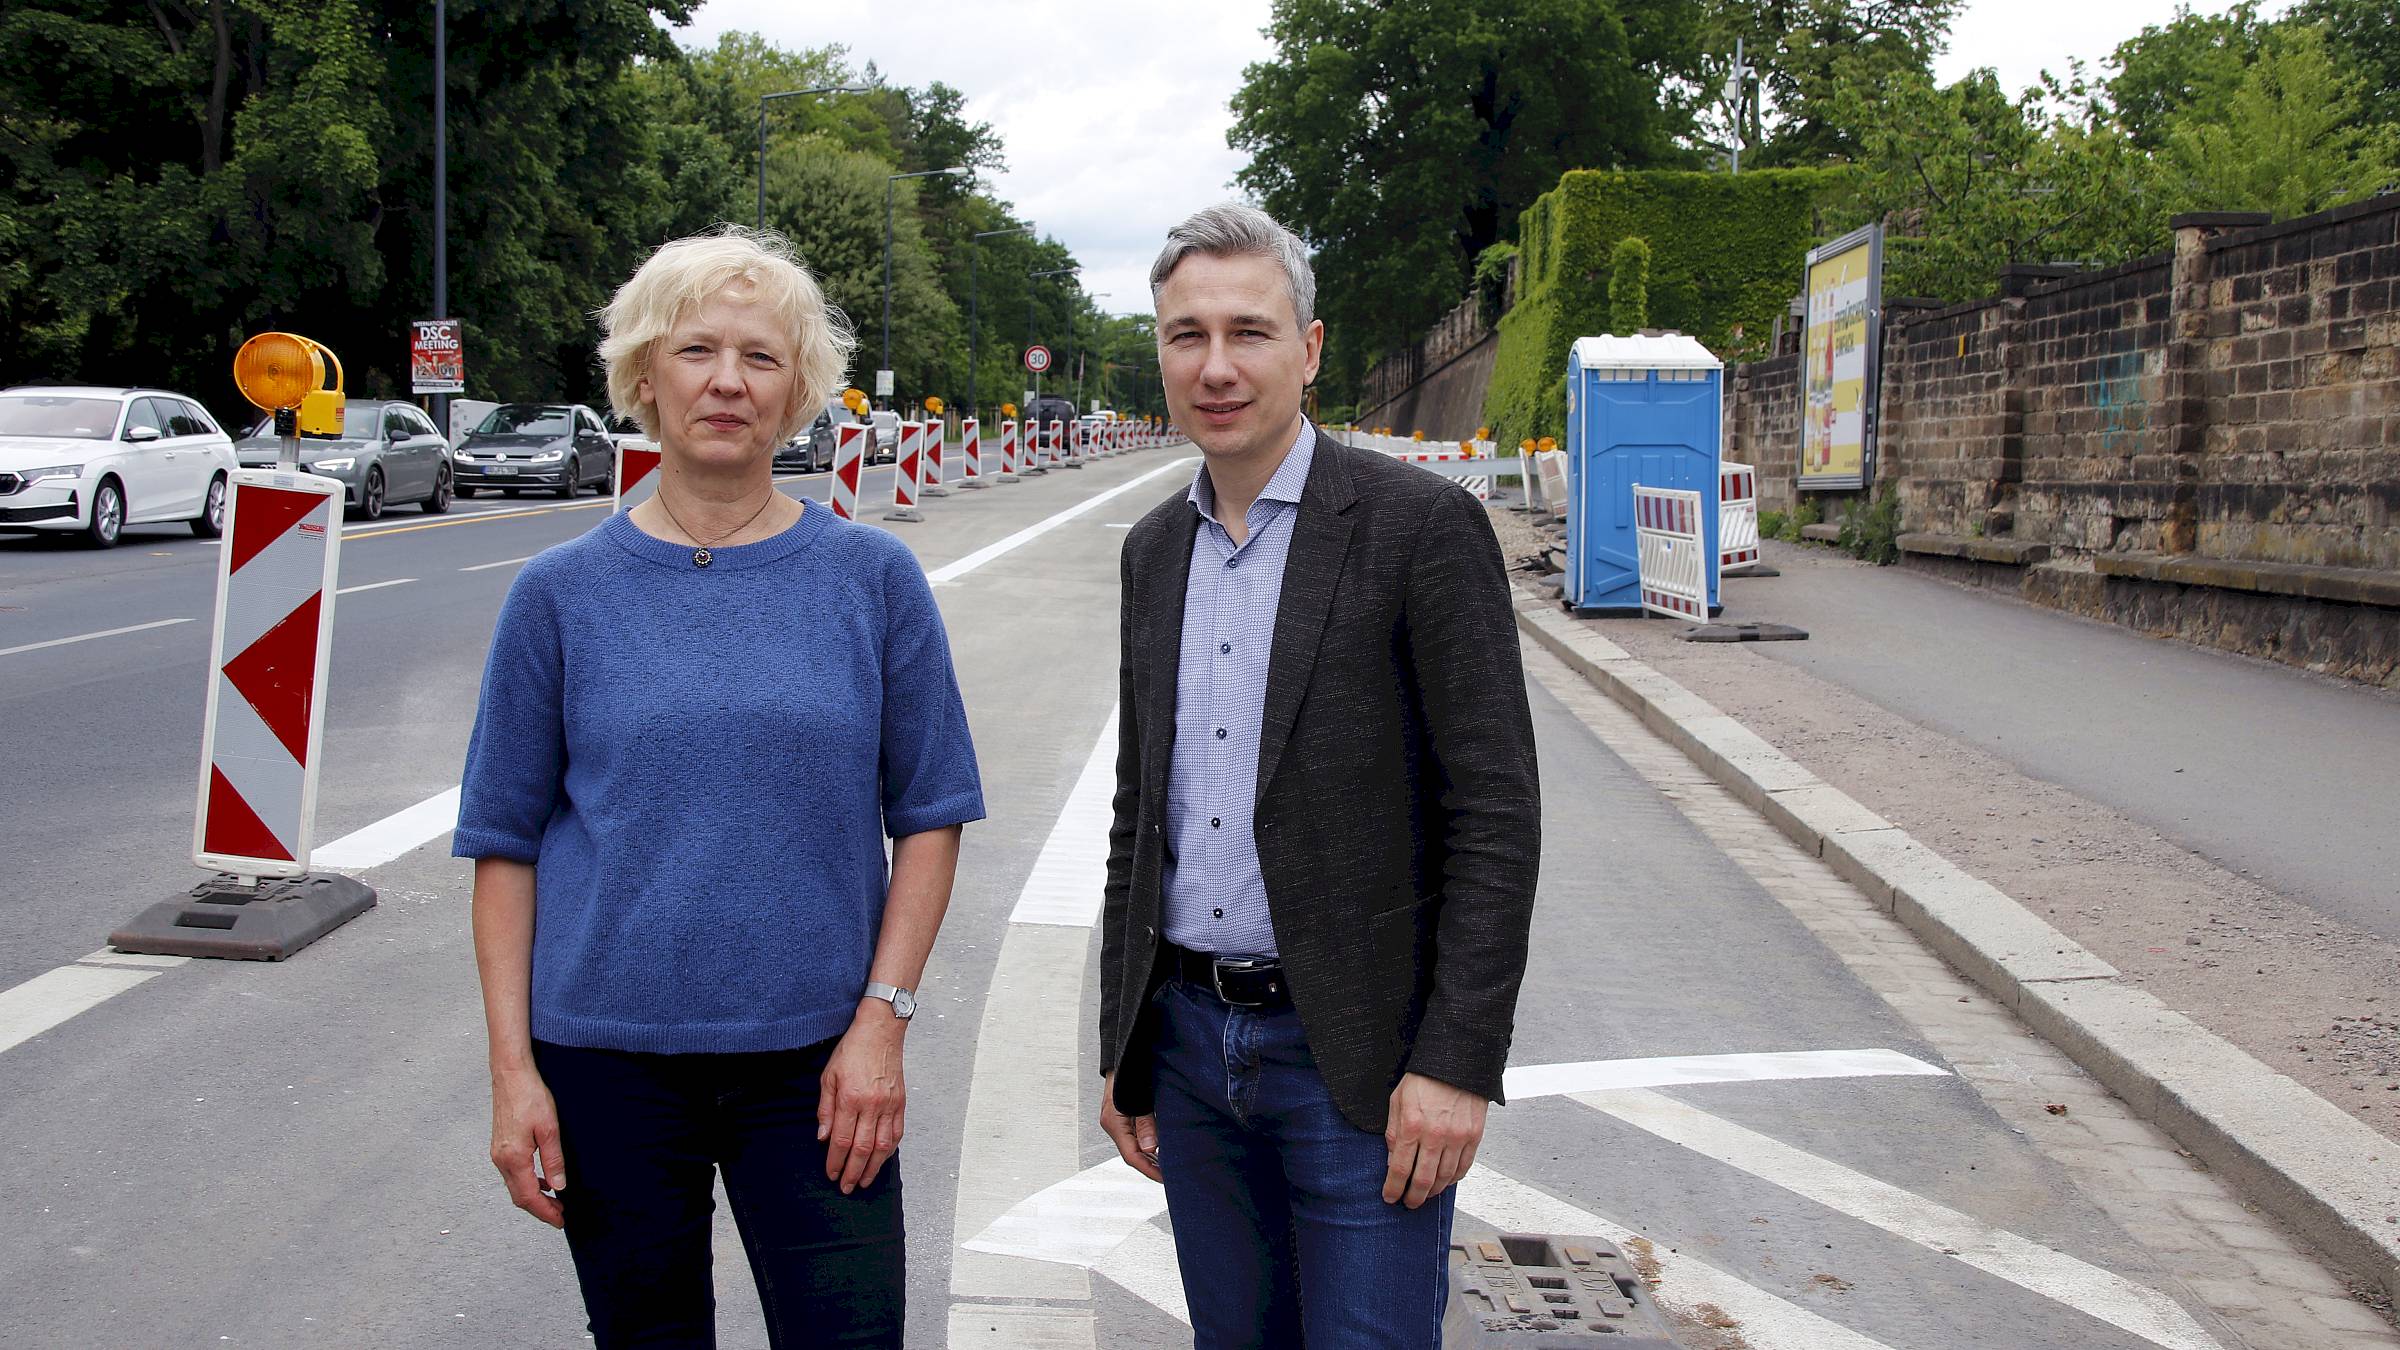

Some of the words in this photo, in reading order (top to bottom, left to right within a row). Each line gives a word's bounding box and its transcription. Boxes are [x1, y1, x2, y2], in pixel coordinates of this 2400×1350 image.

[420, 326, 451, 340] DSC
[415, 339, 459, 350] MEETING
[1031, 353, 1045, 364] 30
